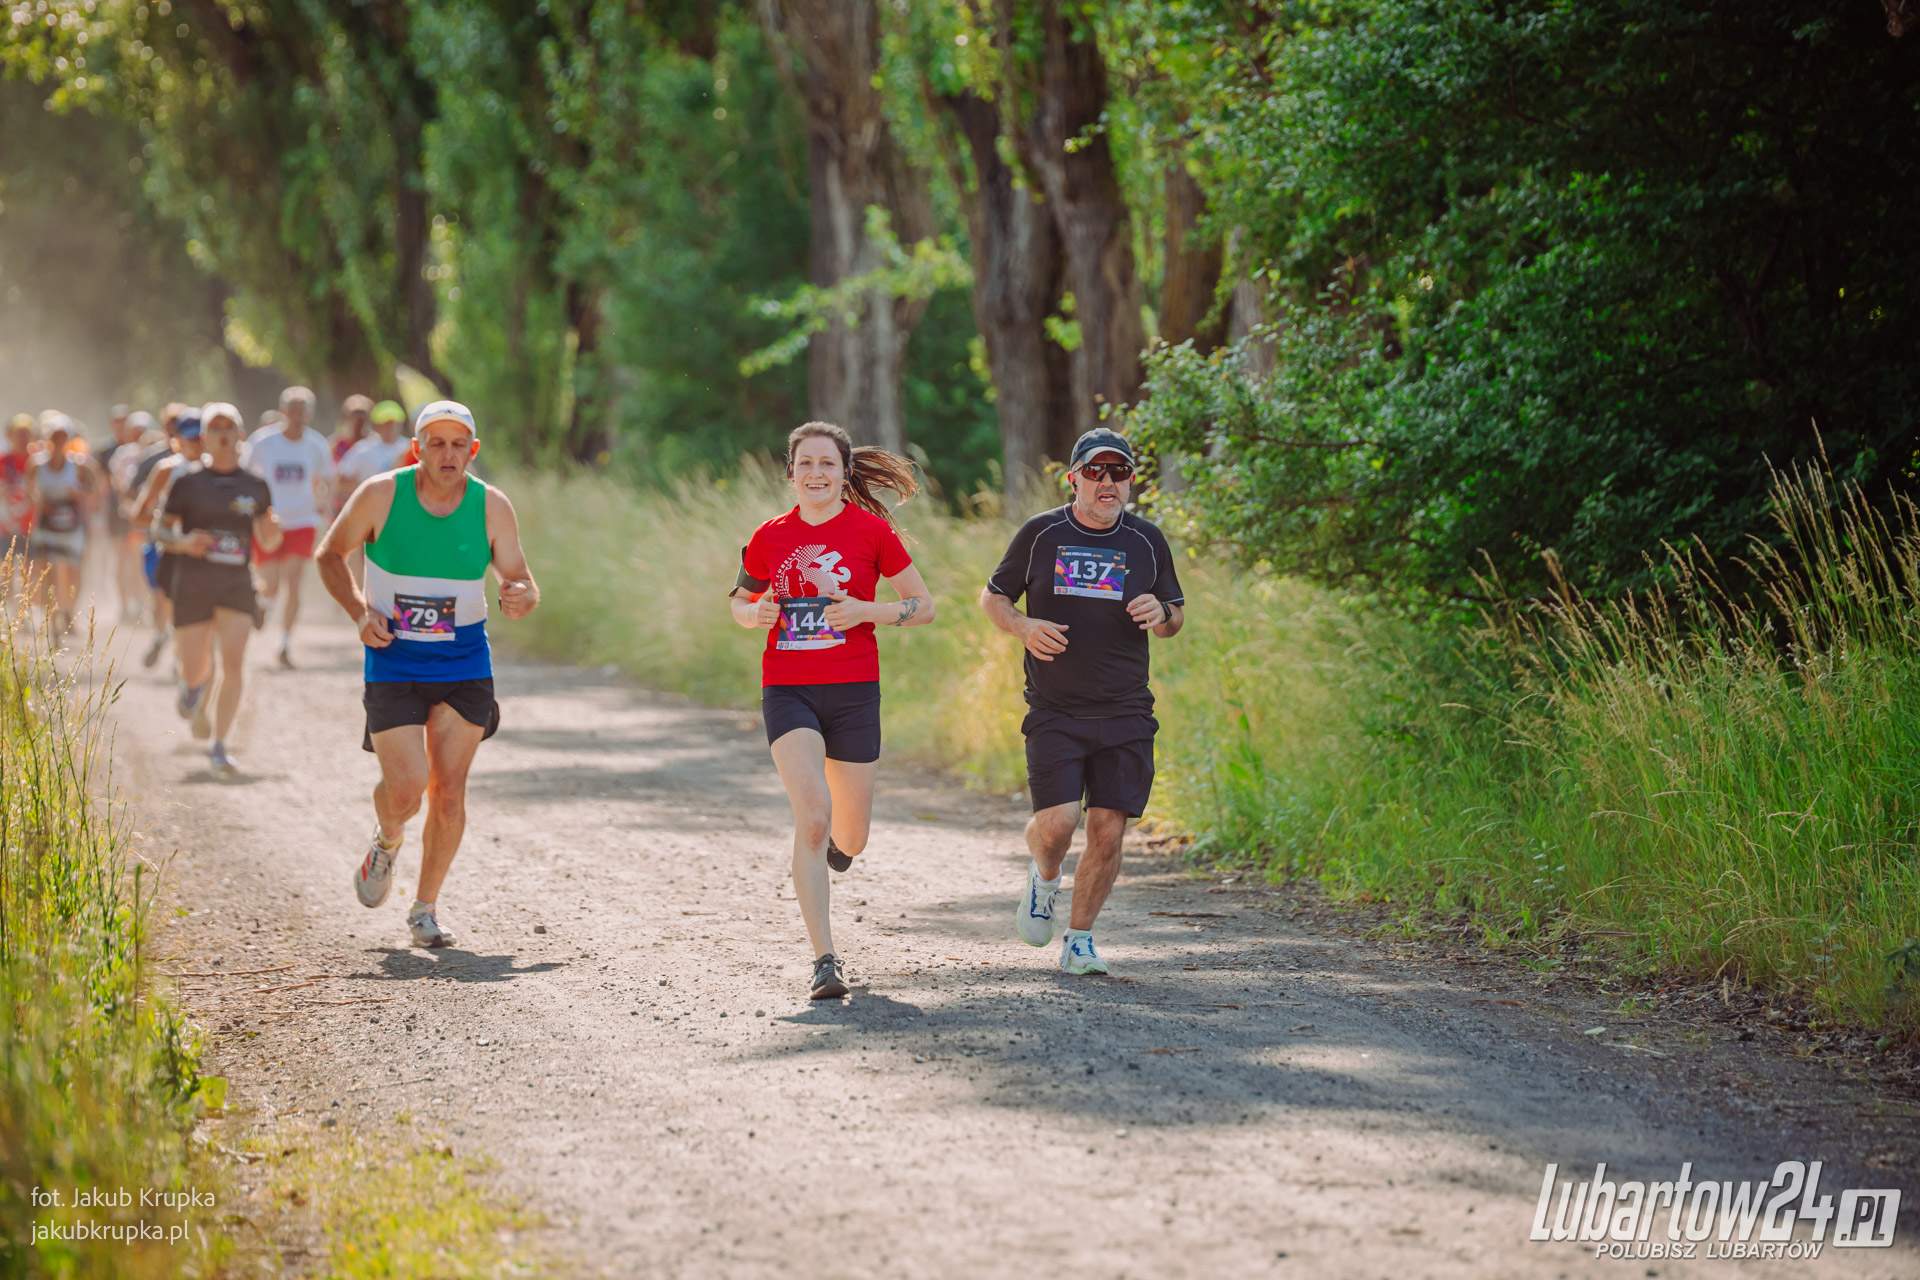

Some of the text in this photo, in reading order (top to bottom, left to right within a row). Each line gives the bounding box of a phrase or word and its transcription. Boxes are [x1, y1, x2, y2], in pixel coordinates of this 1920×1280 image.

[1069, 559, 1113, 581] 137
[410, 607, 439, 626] 79
[790, 611, 830, 632] 144
